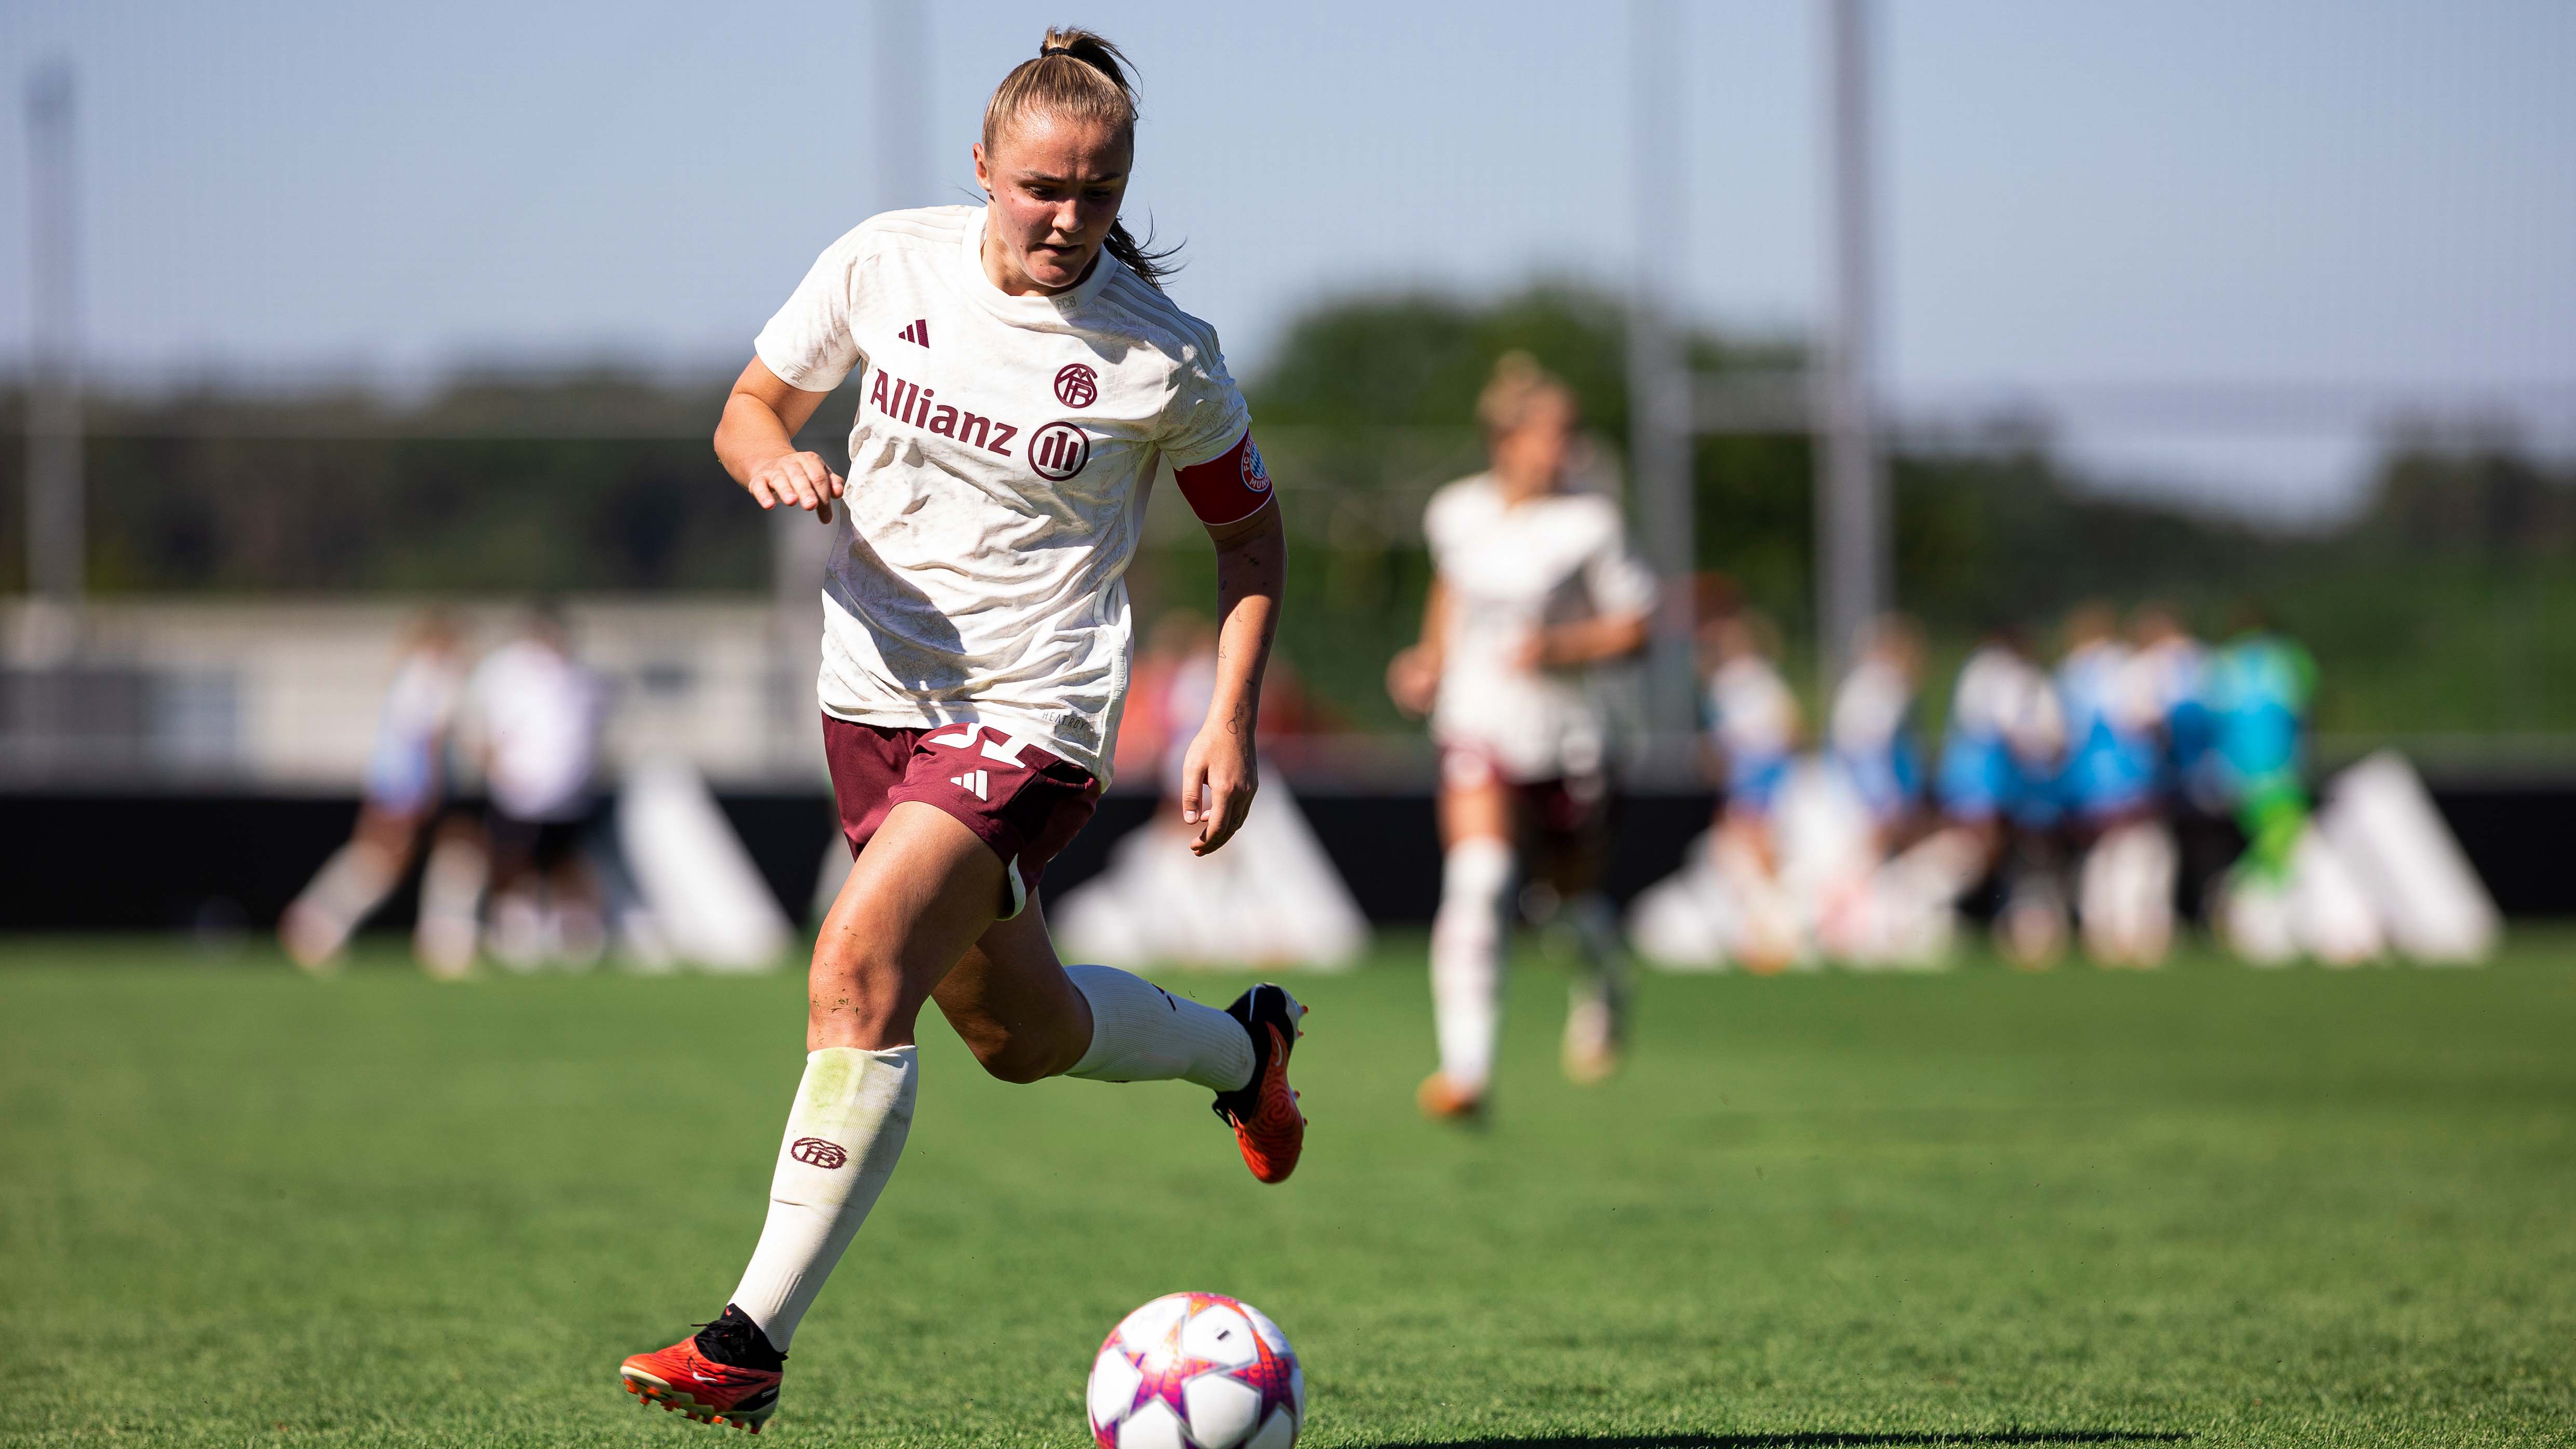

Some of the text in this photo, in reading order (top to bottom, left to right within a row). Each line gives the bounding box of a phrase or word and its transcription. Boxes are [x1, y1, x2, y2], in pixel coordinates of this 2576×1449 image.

[1055, 295, 1076, 310] FCB
[870, 368, 1018, 457] Allianz
[1244, 456, 1250, 471] FC
